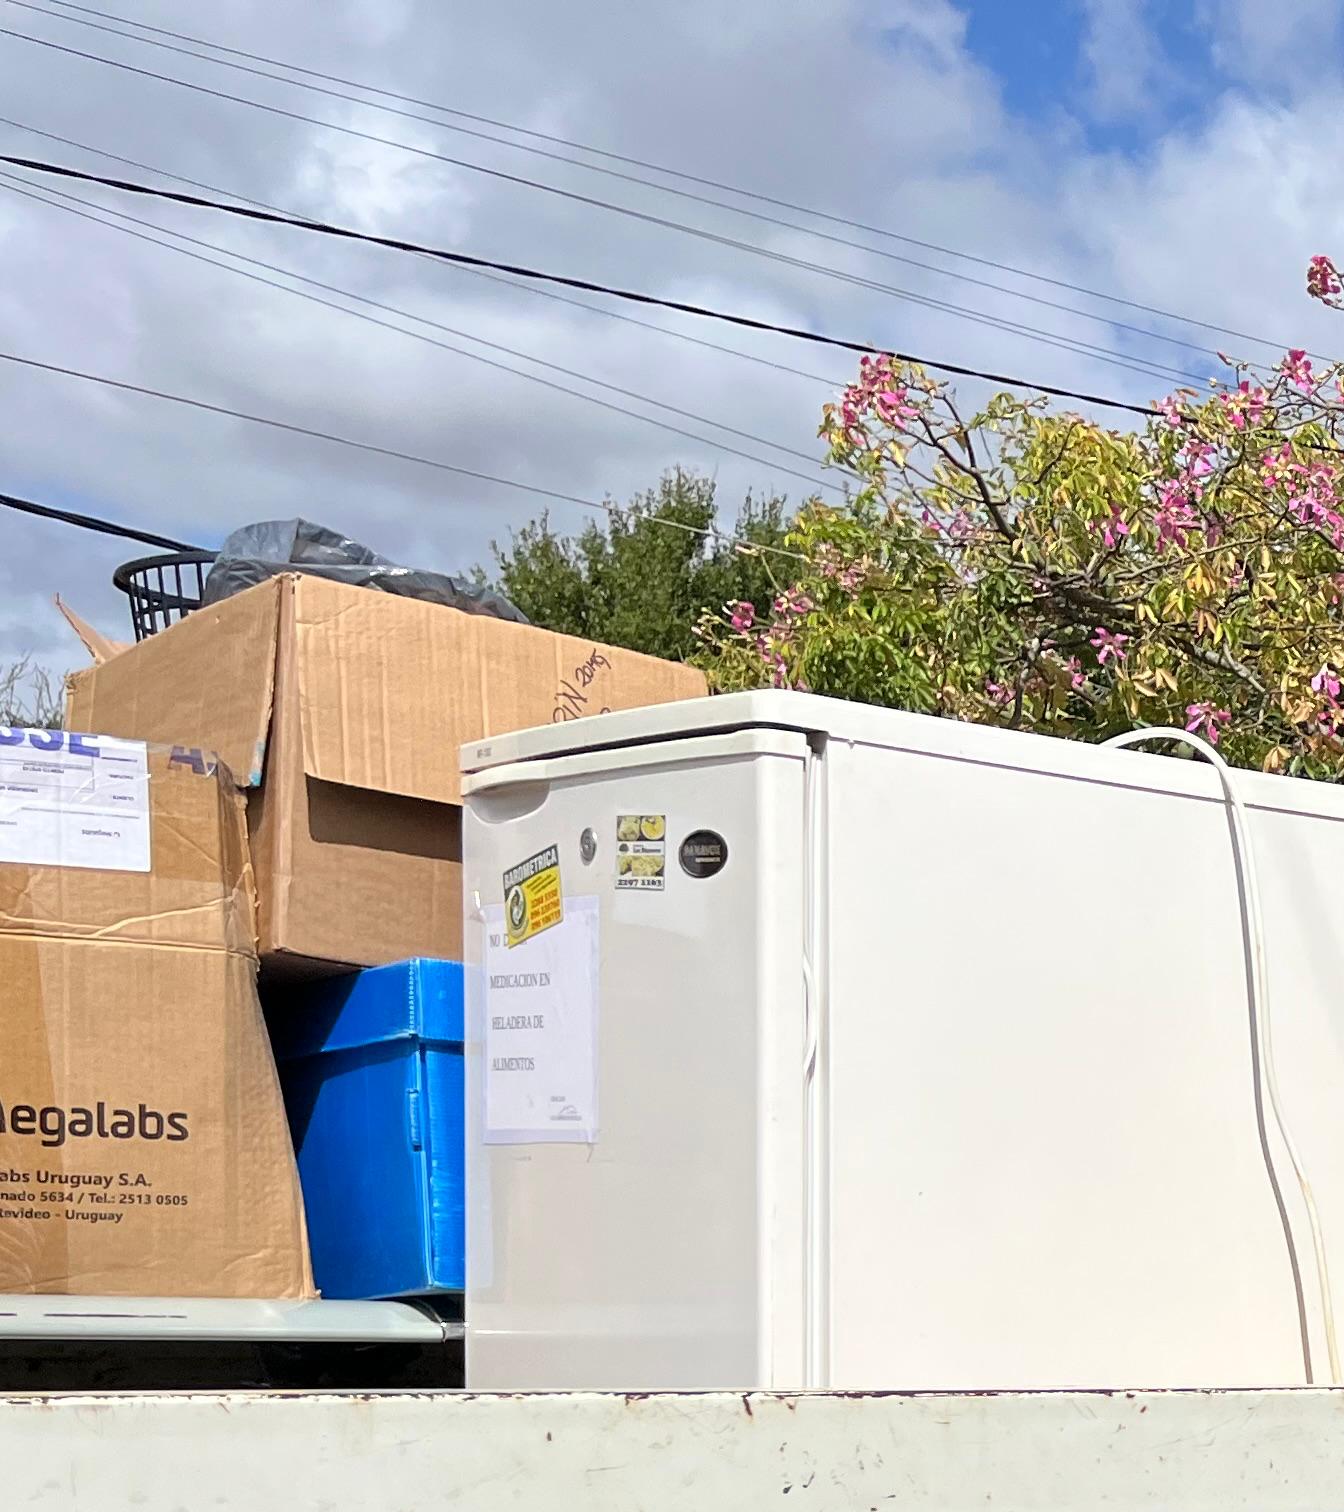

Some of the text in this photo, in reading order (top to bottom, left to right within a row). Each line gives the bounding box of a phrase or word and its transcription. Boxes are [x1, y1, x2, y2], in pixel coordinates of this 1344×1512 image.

[490, 972, 551, 989] MEDICACION EN
[492, 1015, 544, 1029] HELADERA DE
[492, 1057, 535, 1071] ALIMENTOS
[0, 1102, 189, 1147] egalabs
[37, 1171, 113, 1189] Uruguay
[119, 1173, 152, 1187] S.A.
[40, 1192, 73, 1203] 5634
[119, 1194, 151, 1205] 2513
[156, 1195, 188, 1206] 0505
[65, 1210, 123, 1223] Uruguay
